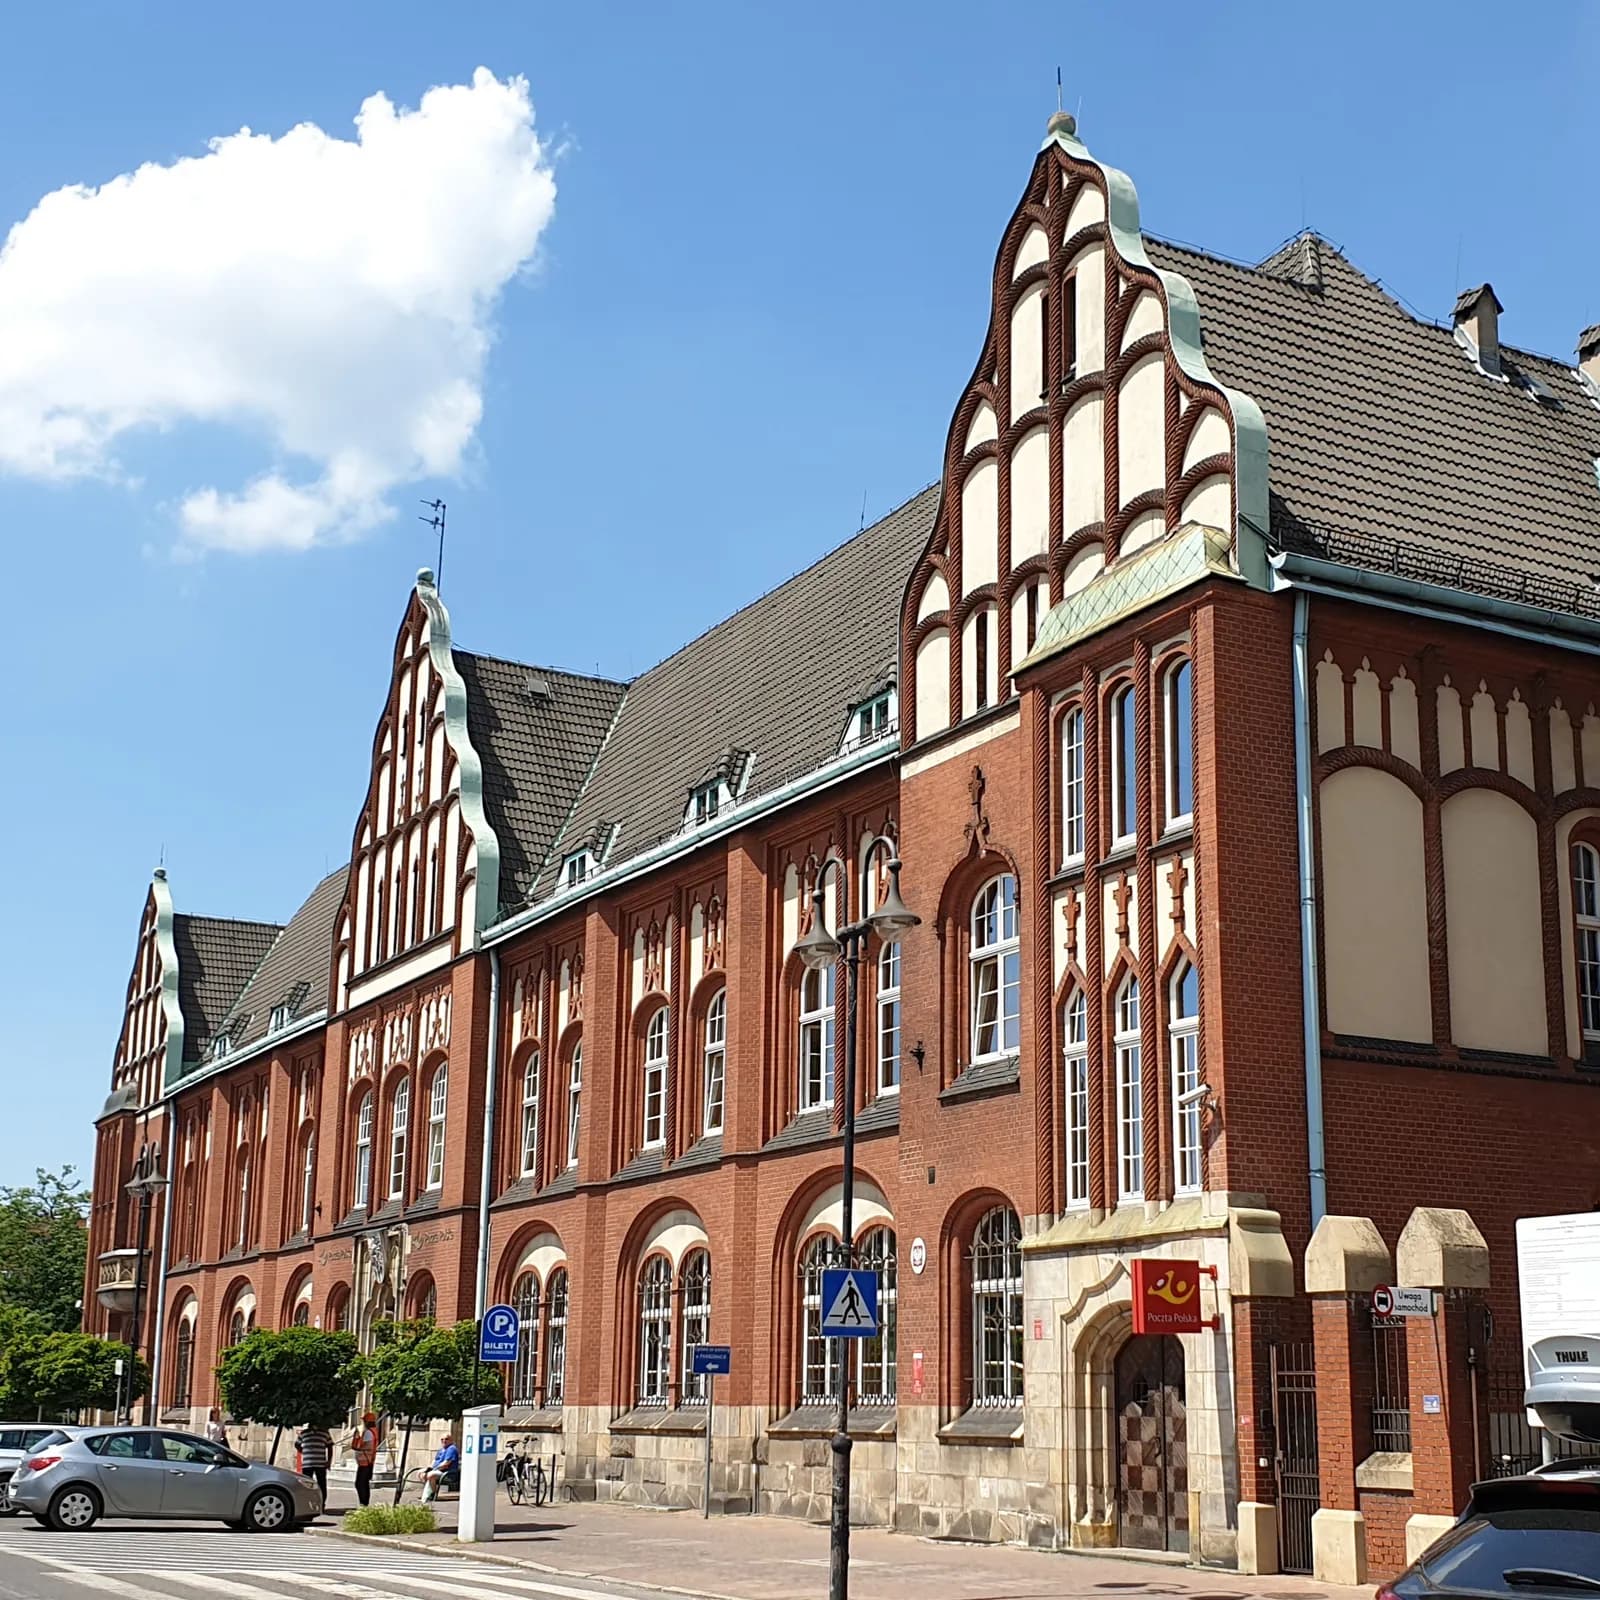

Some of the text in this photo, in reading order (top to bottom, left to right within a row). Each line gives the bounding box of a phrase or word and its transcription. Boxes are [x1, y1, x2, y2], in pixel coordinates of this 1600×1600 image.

[1398, 1291, 1421, 1303] Uwaga
[494, 1315, 509, 1331] P
[1147, 1312, 1198, 1323] Poczta Polska
[484, 1342, 516, 1350] BILETY
[1555, 1351, 1589, 1362] THULE
[482, 1436, 494, 1452] P
